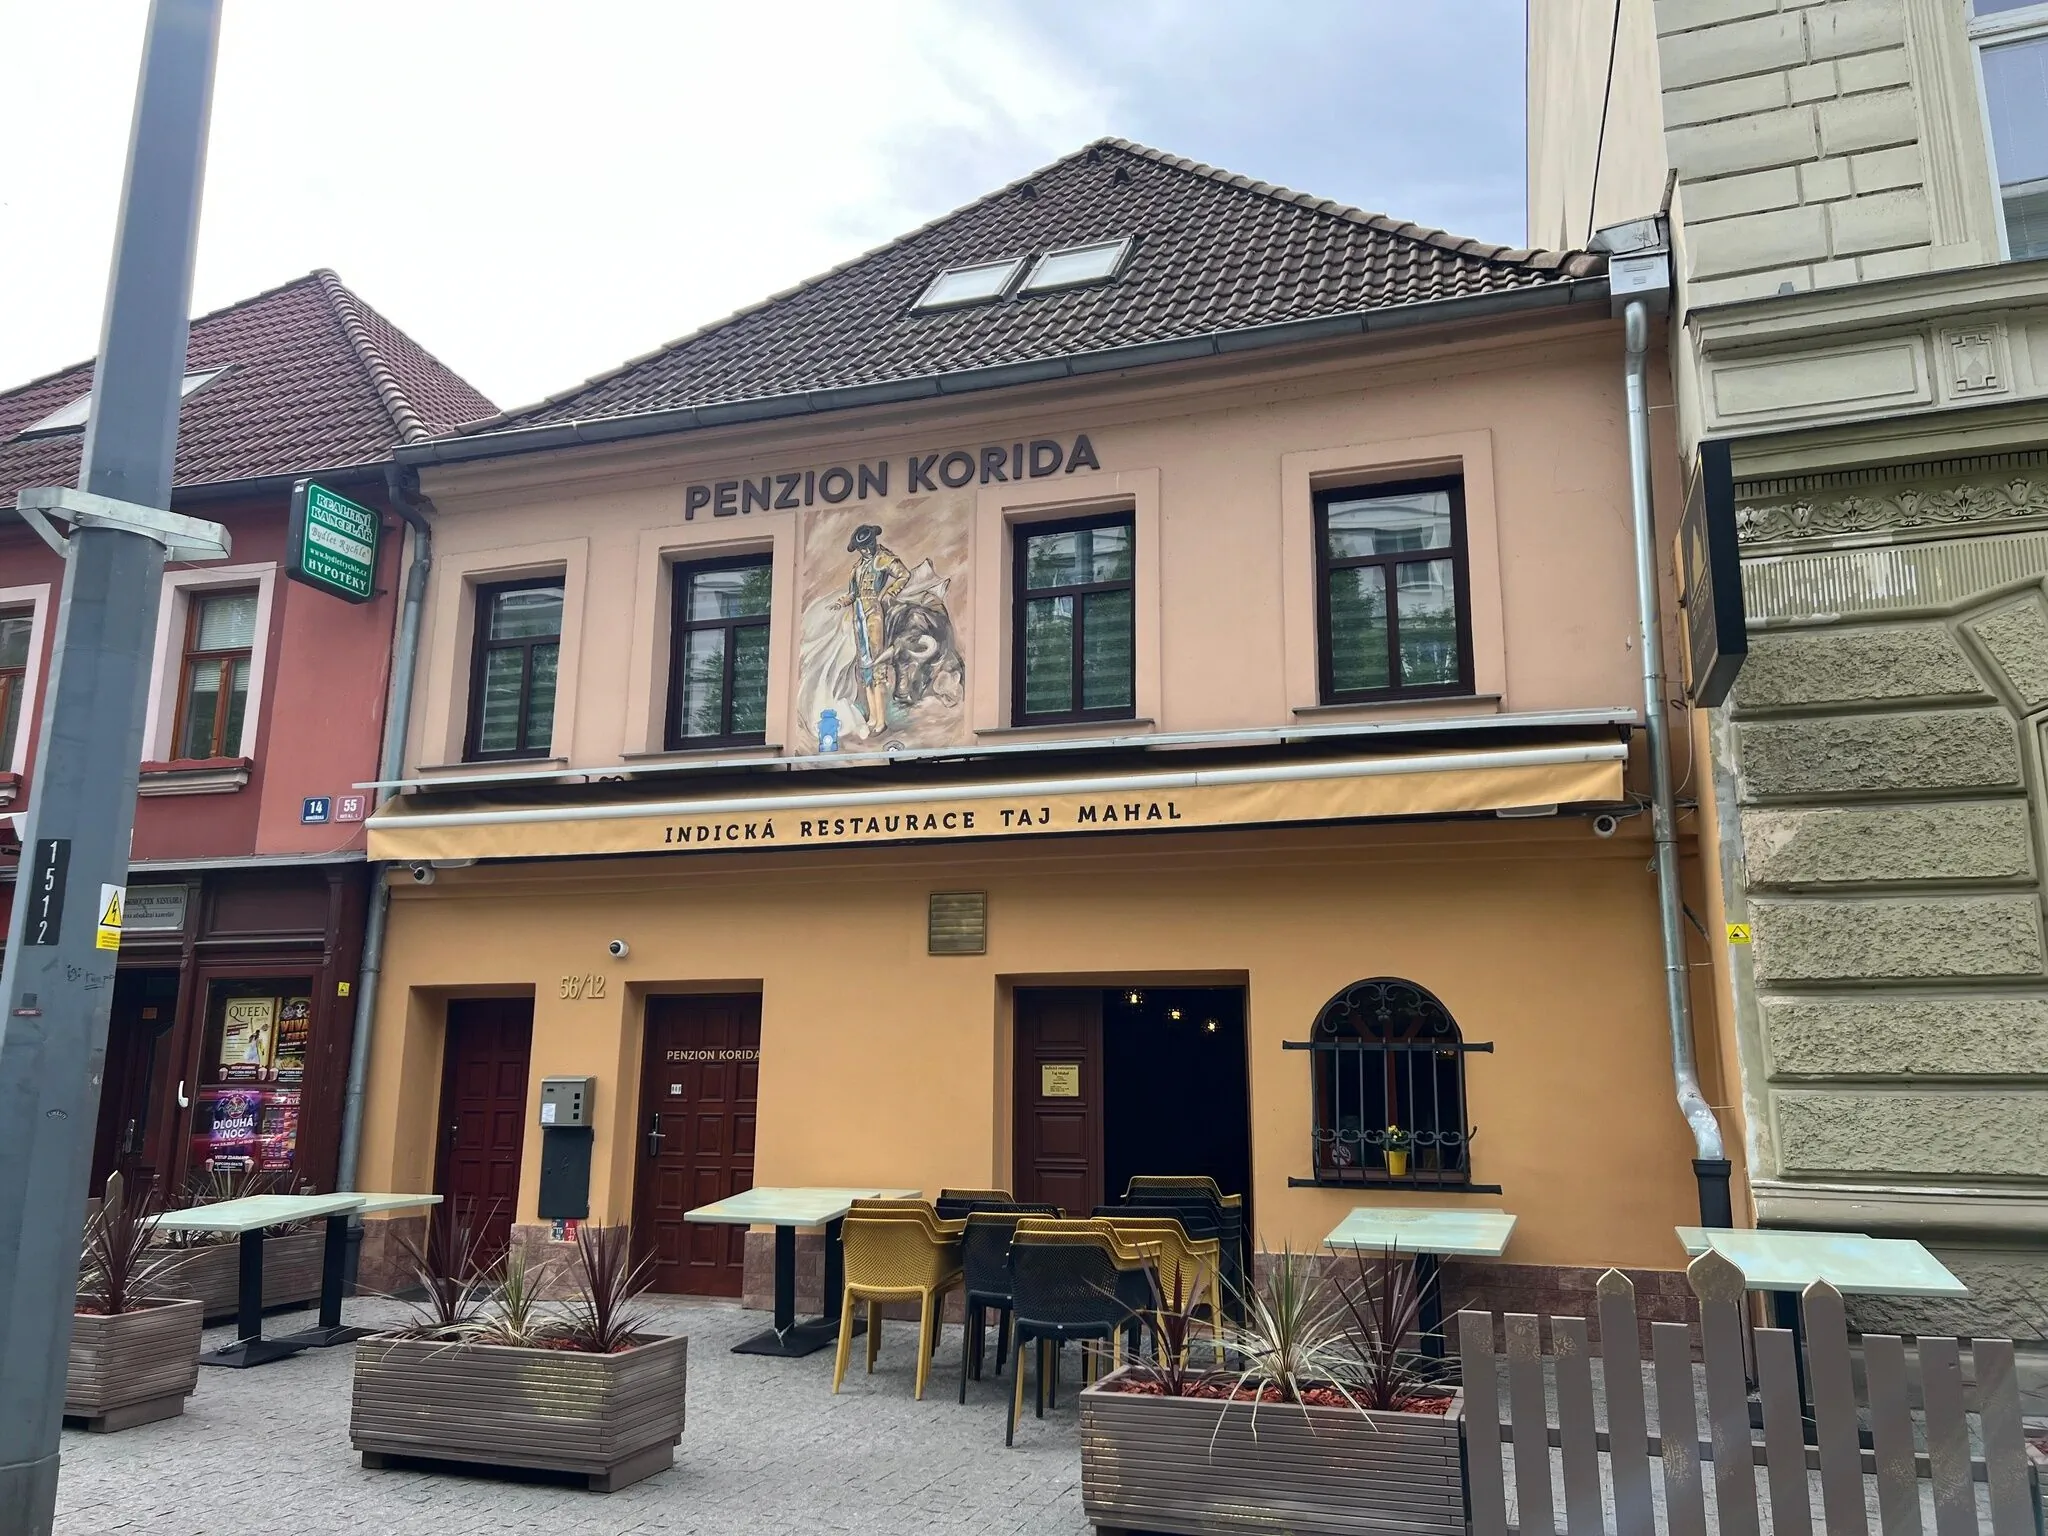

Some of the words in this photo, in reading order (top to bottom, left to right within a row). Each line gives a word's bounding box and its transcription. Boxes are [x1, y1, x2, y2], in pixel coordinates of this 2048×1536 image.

[685, 461, 888, 520] PENZION
[908, 434, 1100, 494] KORIDA
[317, 494, 371, 526] REALITNÍ
[311, 506, 373, 543] KANCELÁŘ
[308, 558, 367, 591] HYPOTÉKY
[309, 548, 367, 577] www.bydletrychle.cz
[310, 800, 323, 814] 14
[343, 799, 358, 812] 55
[665, 819, 776, 843] INDICKÁ
[801, 811, 976, 838] RESTAURACE
[1000, 807, 1052, 827] TAJ
[1078, 802, 1182, 823] MAHAL
[559, 974, 606, 1000] 56/12
[229, 1006, 270, 1022] QUEEN
[666, 1050, 715, 1060] PENZION
[720, 1050, 760, 1060] KORIDA
[213, 1114, 254, 1130] DLOUHÁ
[222, 1129, 246, 1138] NOC
